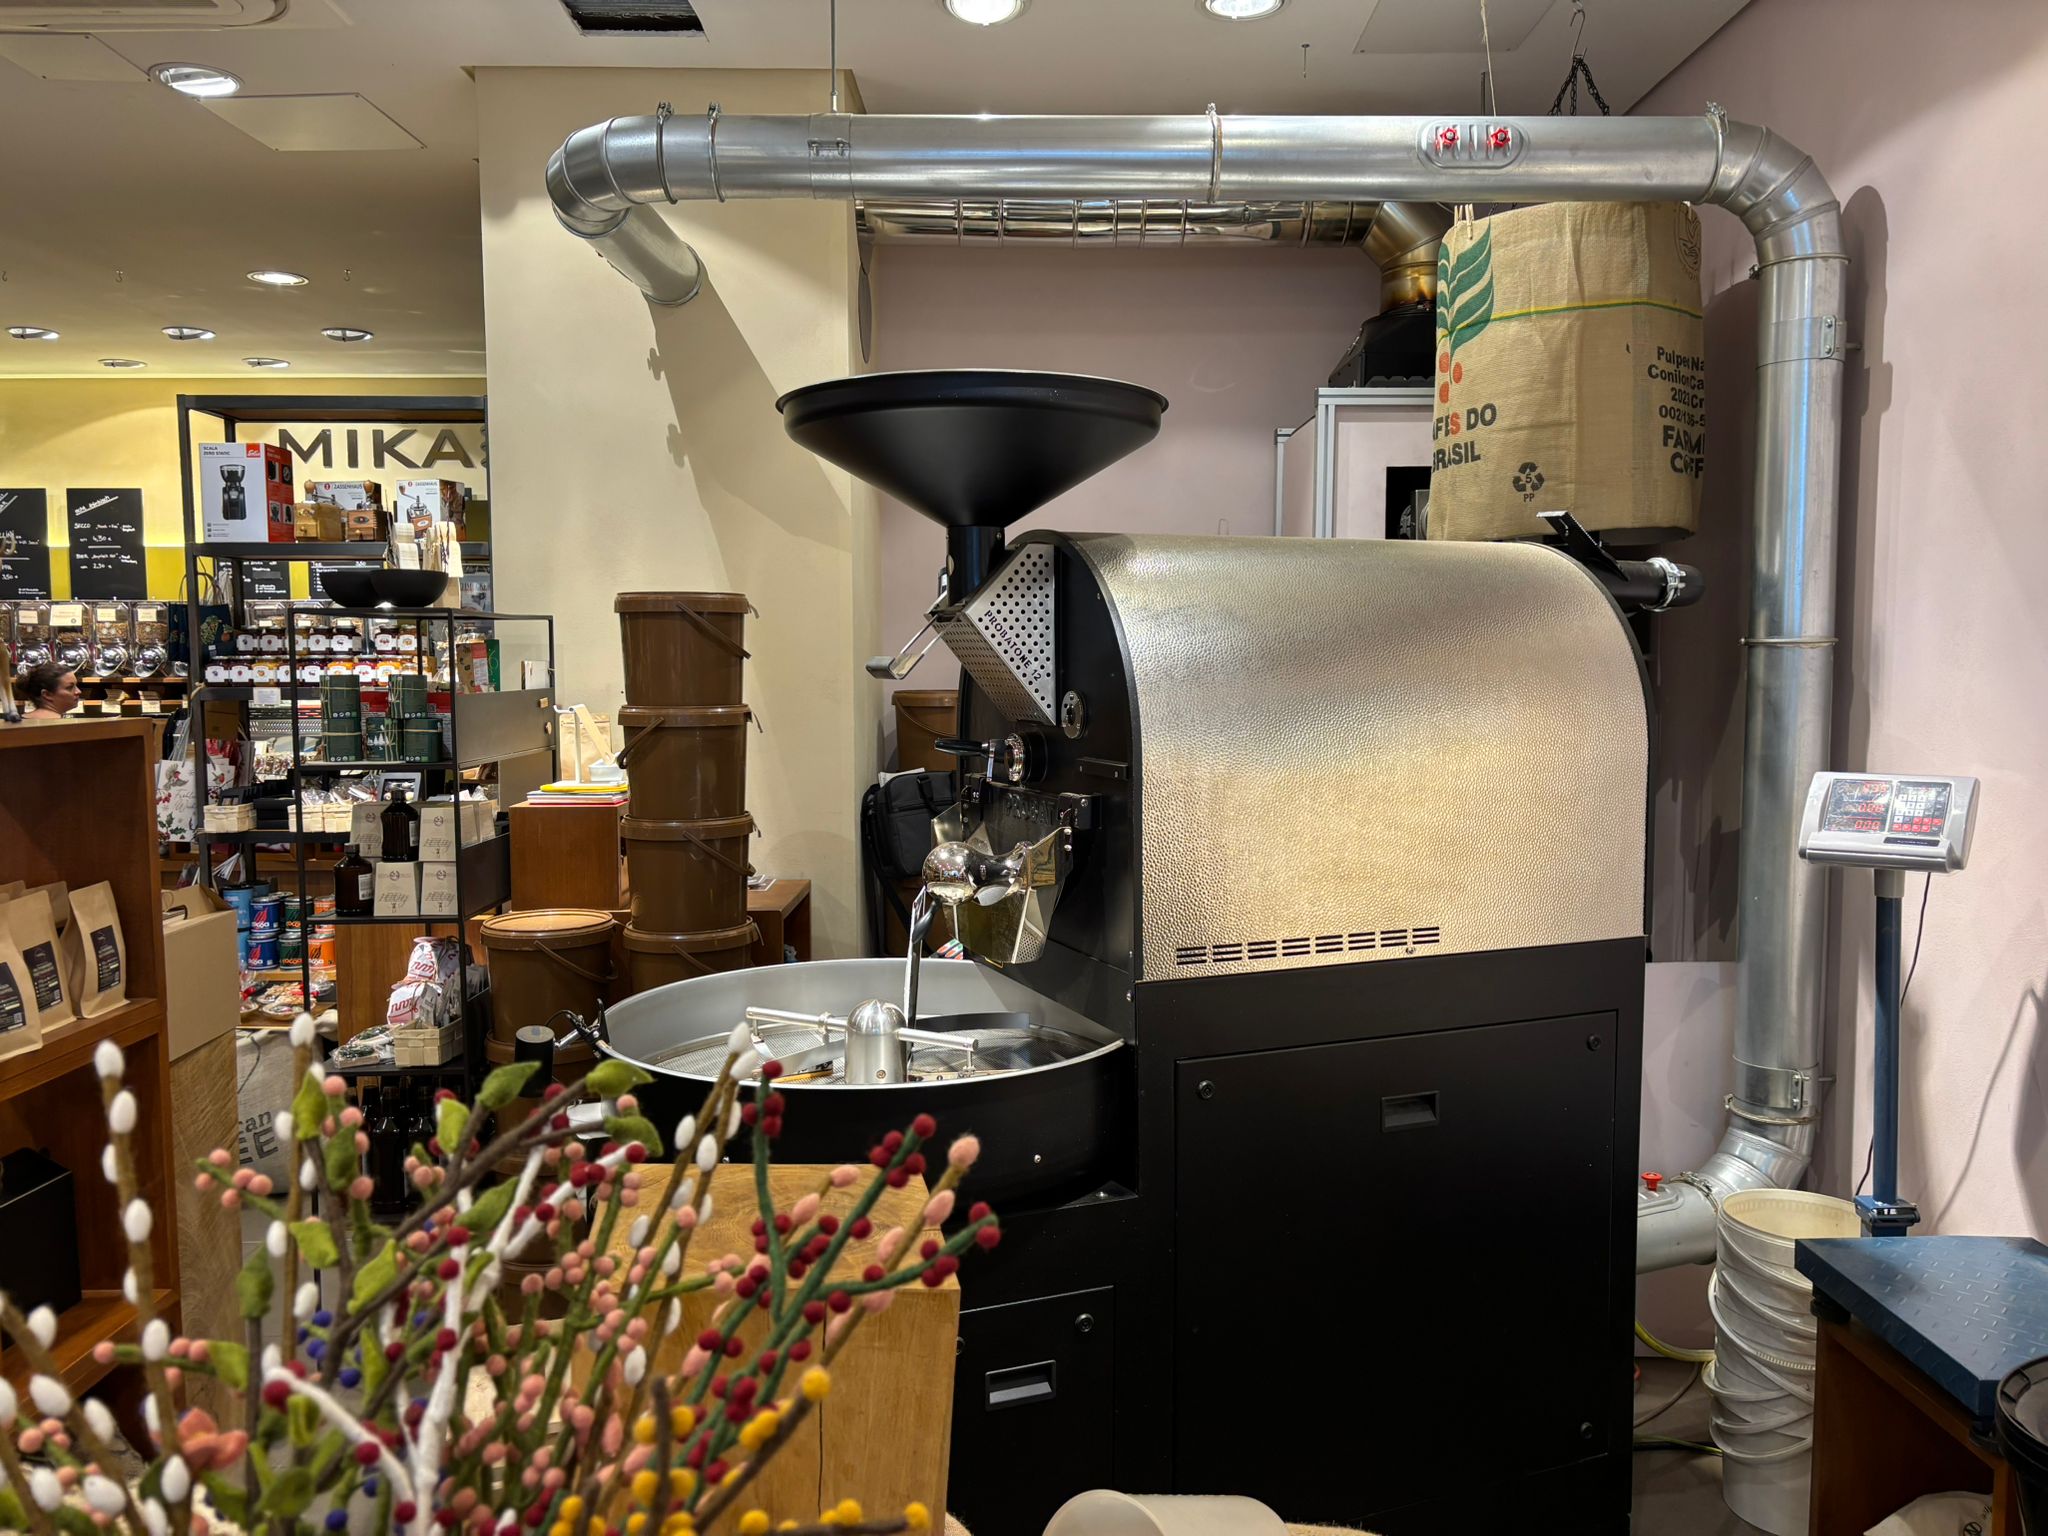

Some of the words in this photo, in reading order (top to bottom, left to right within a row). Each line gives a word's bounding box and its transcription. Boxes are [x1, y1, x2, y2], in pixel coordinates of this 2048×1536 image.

[1466, 402, 1497, 431] DO
[1523, 494, 1535, 502] PP
[984, 610, 1032, 669] PROBATONE
[1031, 669, 1042, 682] 12
